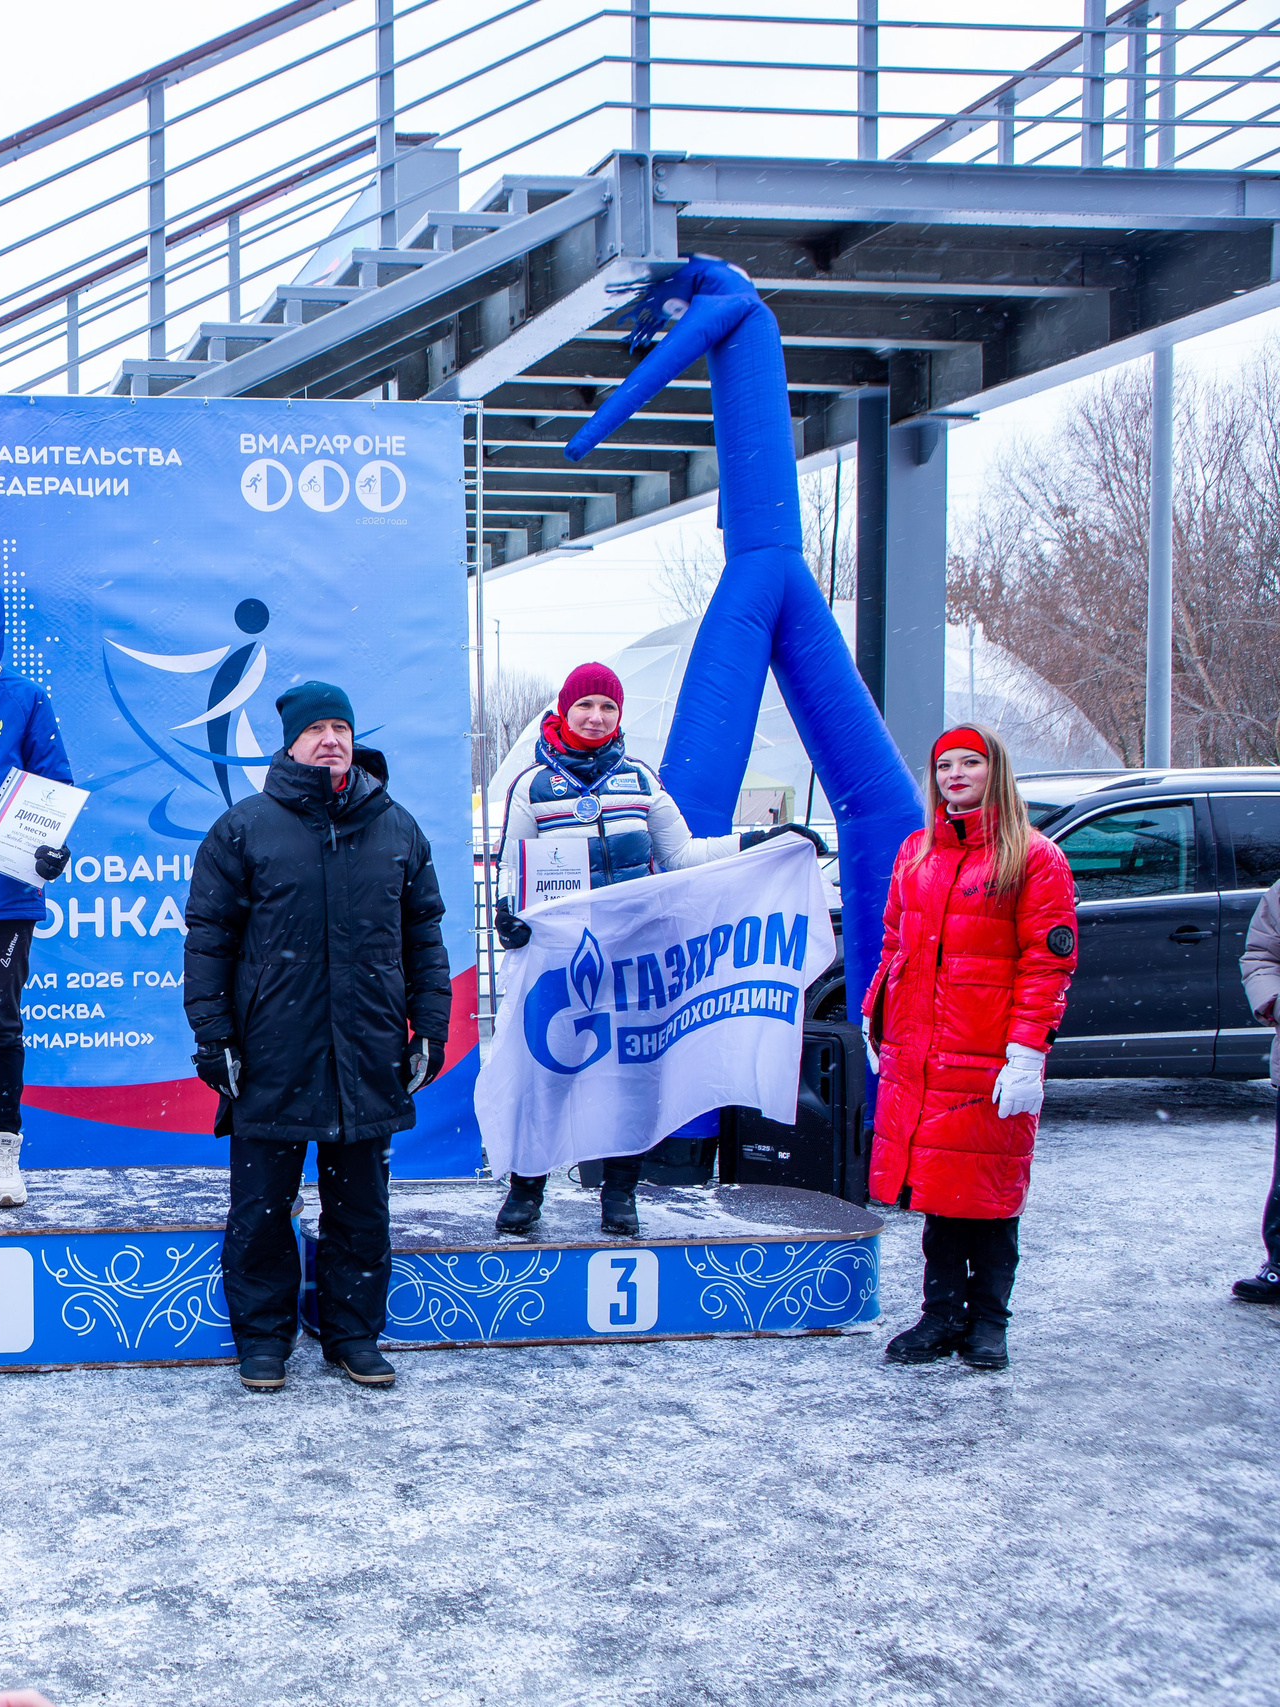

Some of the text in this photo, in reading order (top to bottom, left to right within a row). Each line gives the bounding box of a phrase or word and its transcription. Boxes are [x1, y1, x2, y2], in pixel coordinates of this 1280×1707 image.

[240, 433, 407, 456] ВМАРАФОНЕ
[362, 517, 386, 525] 2020
[386, 518, 408, 526] года
[15, 809, 61, 831] ДИПЛОМ
[536, 879, 581, 892] ДИПЛОМ
[32, 896, 189, 939] ОНКА
[612, 912, 808, 1012] ГАЗПРОМ
[24, 973, 57, 989] ЛЯ
[625, 988, 793, 1057] ЭНЕРГОХОЛДИНГ
[610, 1258, 637, 1325] 3
